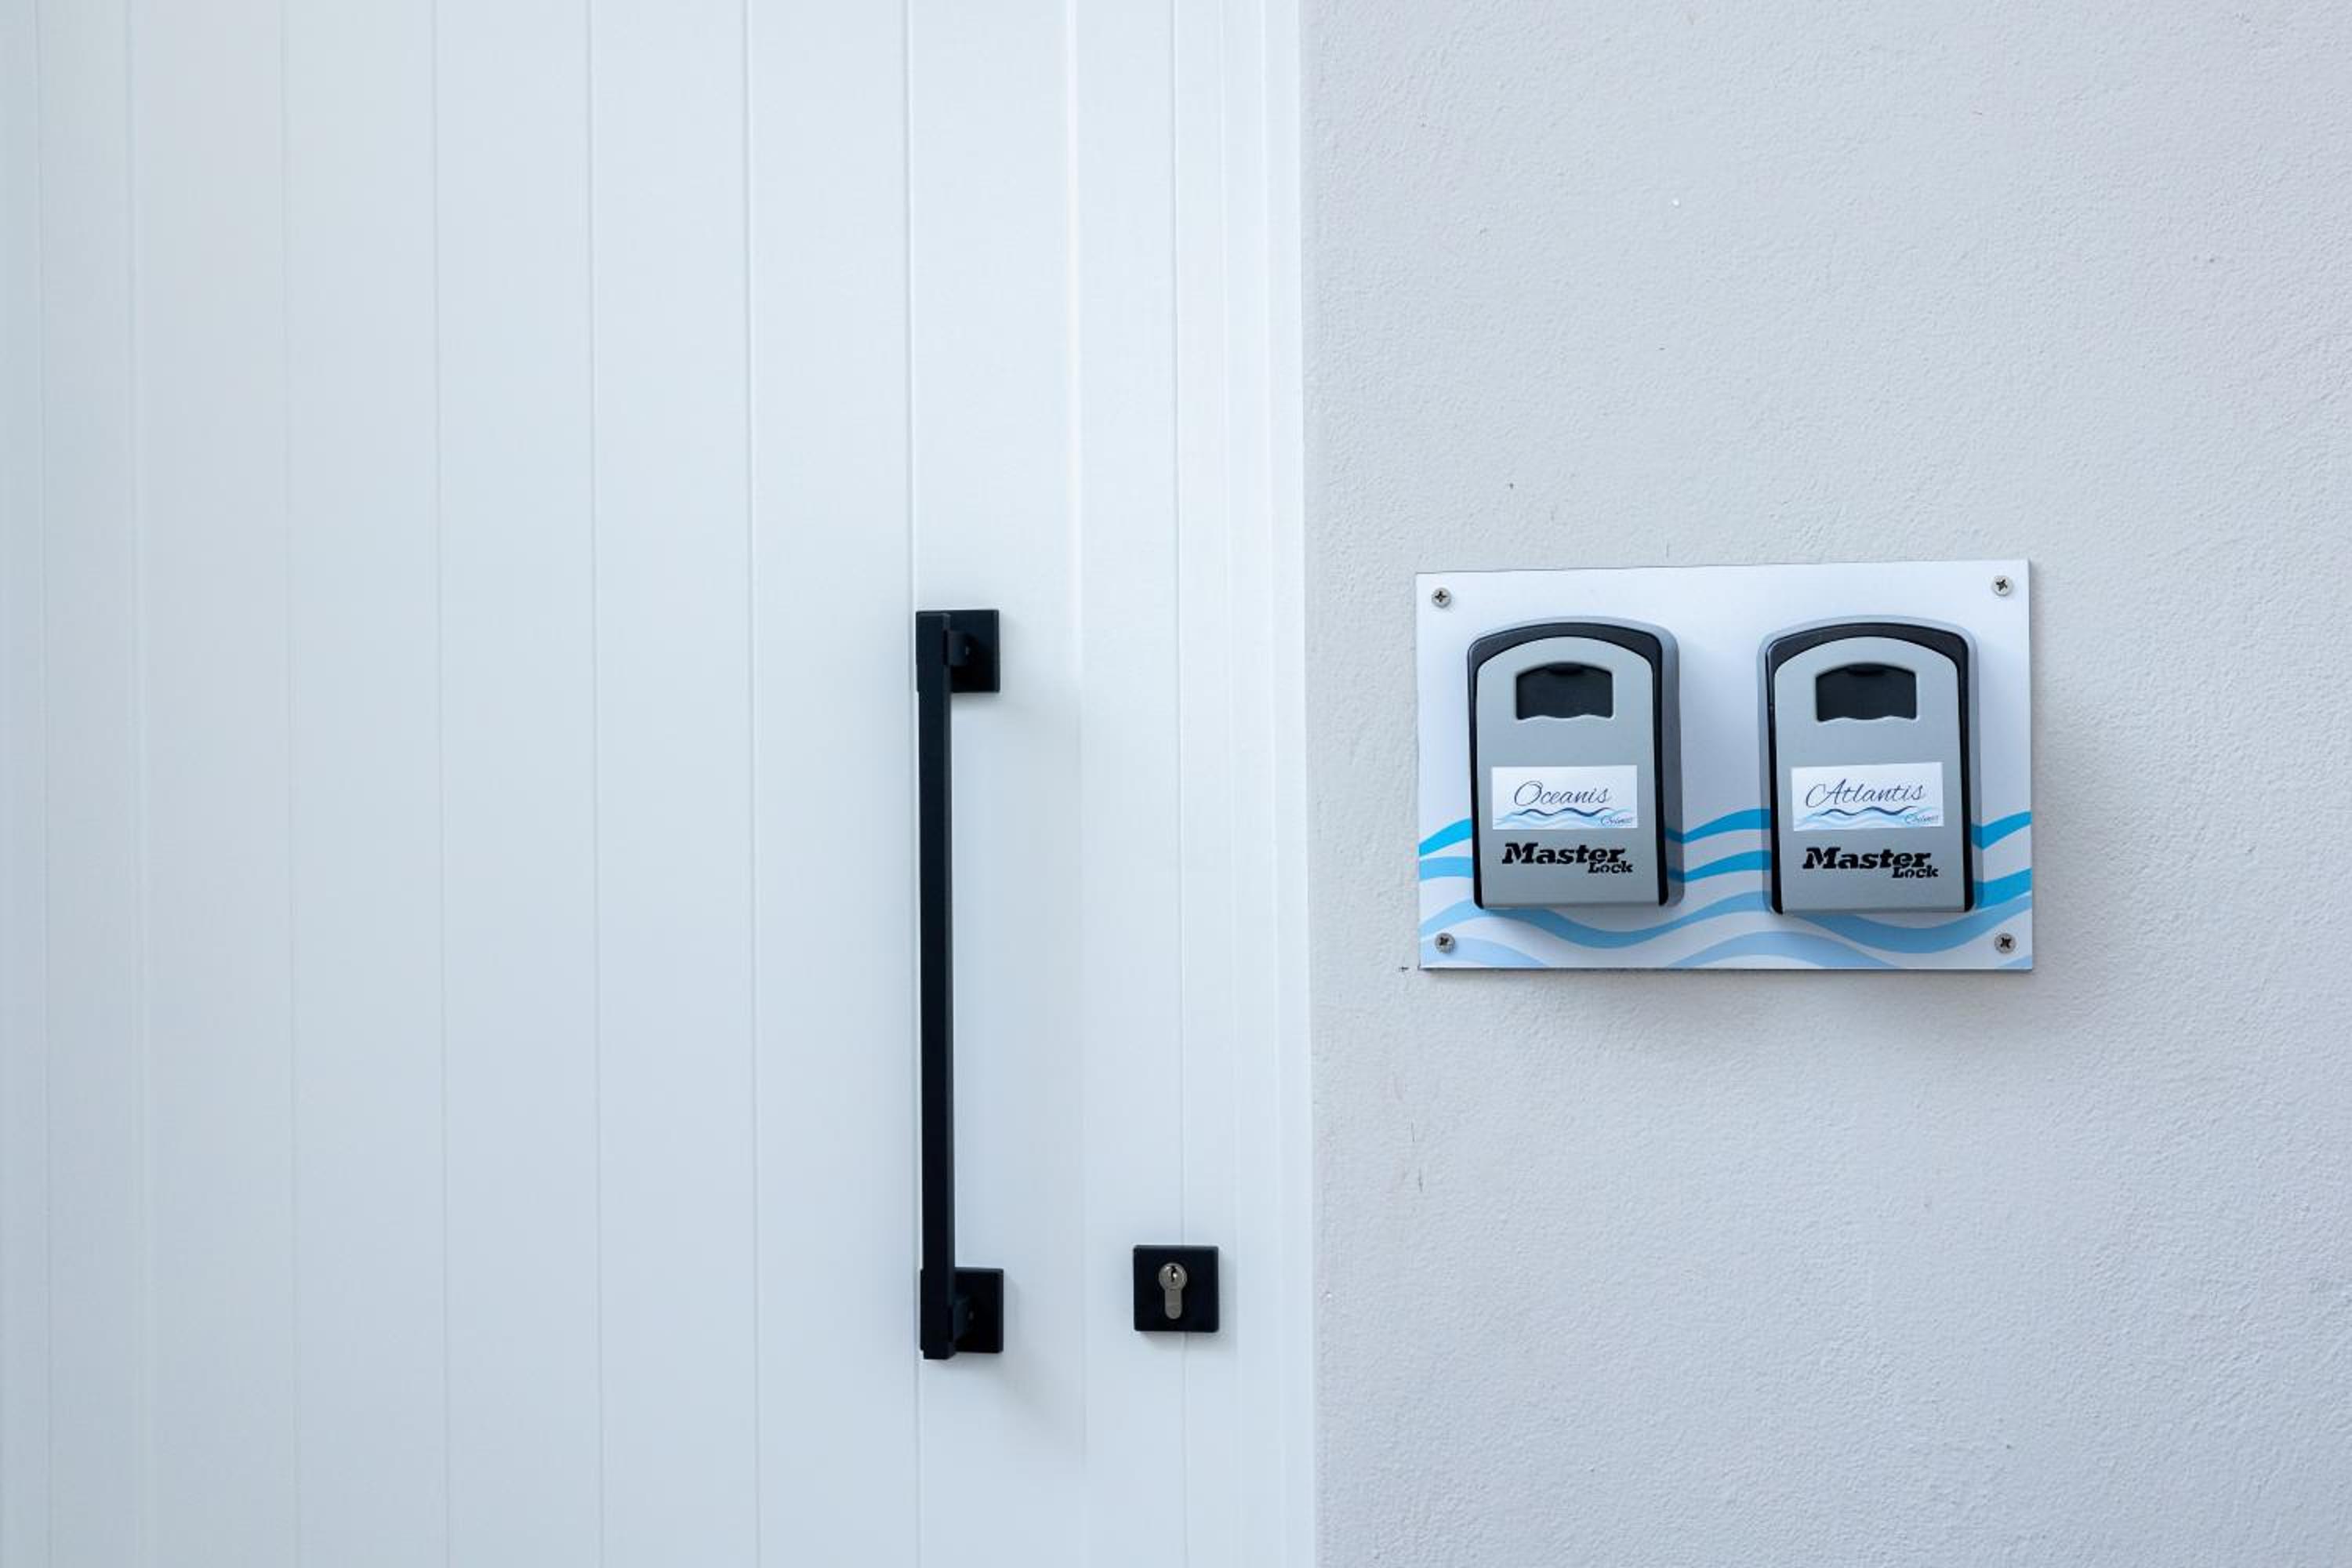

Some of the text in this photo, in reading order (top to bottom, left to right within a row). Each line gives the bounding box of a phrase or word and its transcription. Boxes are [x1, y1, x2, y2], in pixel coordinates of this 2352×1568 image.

[1514, 780, 1611, 807] Oceanis
[1806, 779, 1926, 808] Atlantis
[1501, 842, 1626, 865] Master
[1802, 847, 1932, 869] Master
[1588, 861, 1633, 874] Lock
[1892, 865, 1939, 879] Lock
